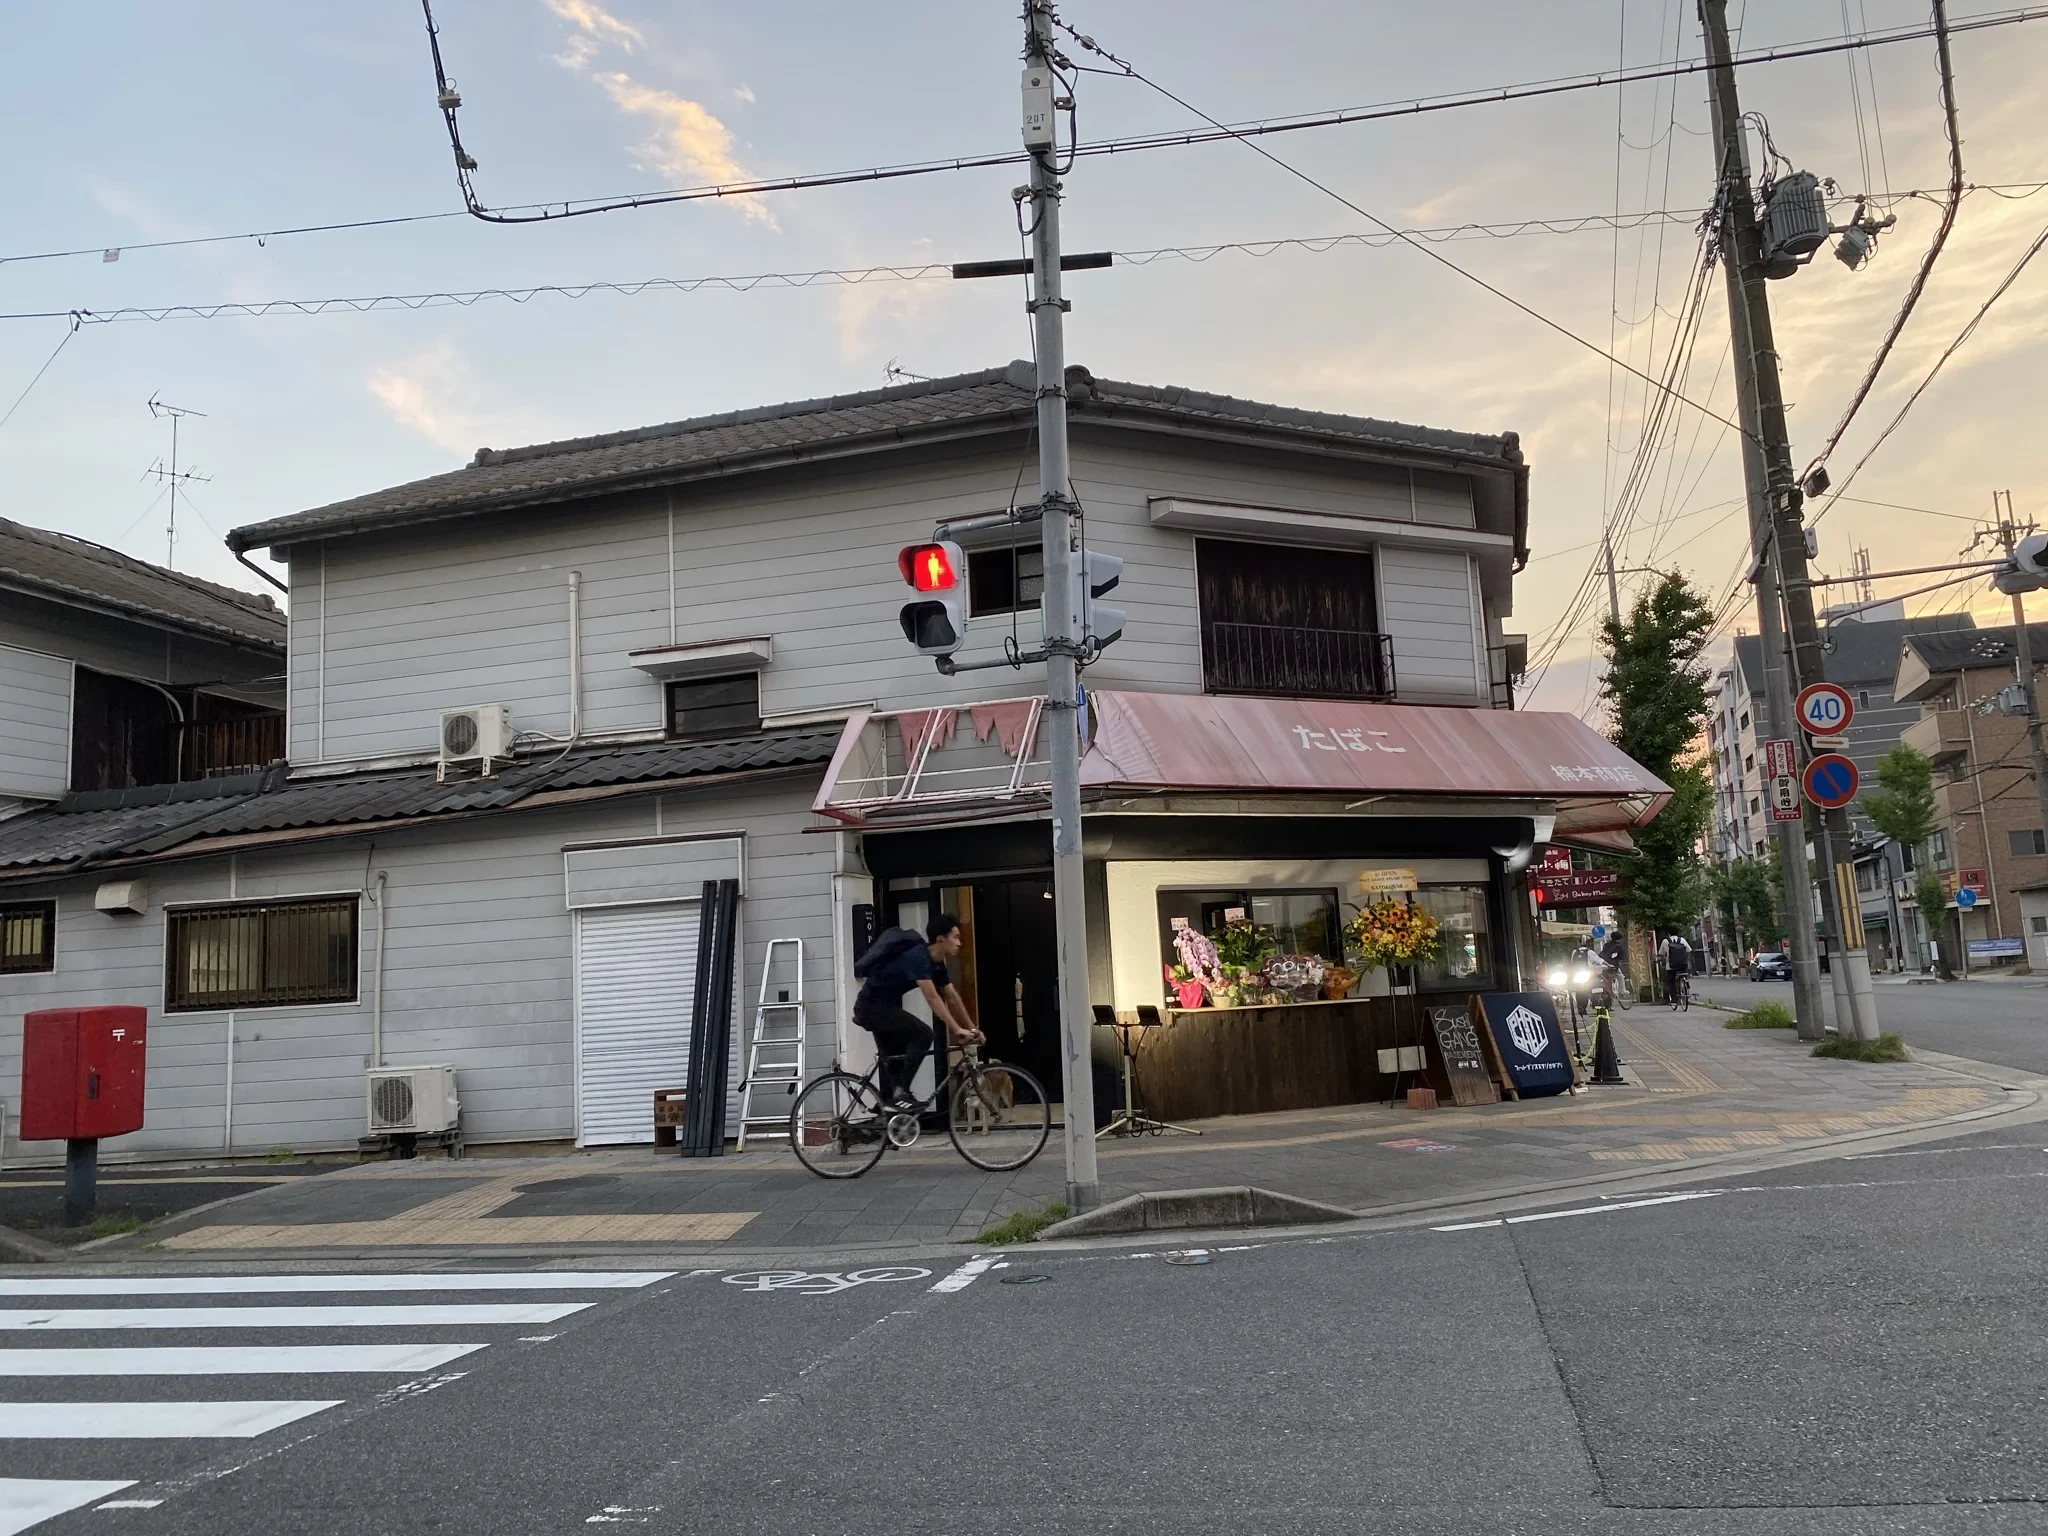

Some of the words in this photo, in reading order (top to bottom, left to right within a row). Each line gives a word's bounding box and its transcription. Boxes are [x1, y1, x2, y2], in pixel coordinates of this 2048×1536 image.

[1026, 113, 1046, 125] 20T
[1809, 698, 1841, 721] 40
[1292, 724, 1407, 753] たばこ
[1550, 765, 1640, 782] 楠本商店
[1539, 859, 1569, 871] 小梅
[1585, 874, 1618, 885] パン工房
[1440, 1031, 1479, 1050] GANG
